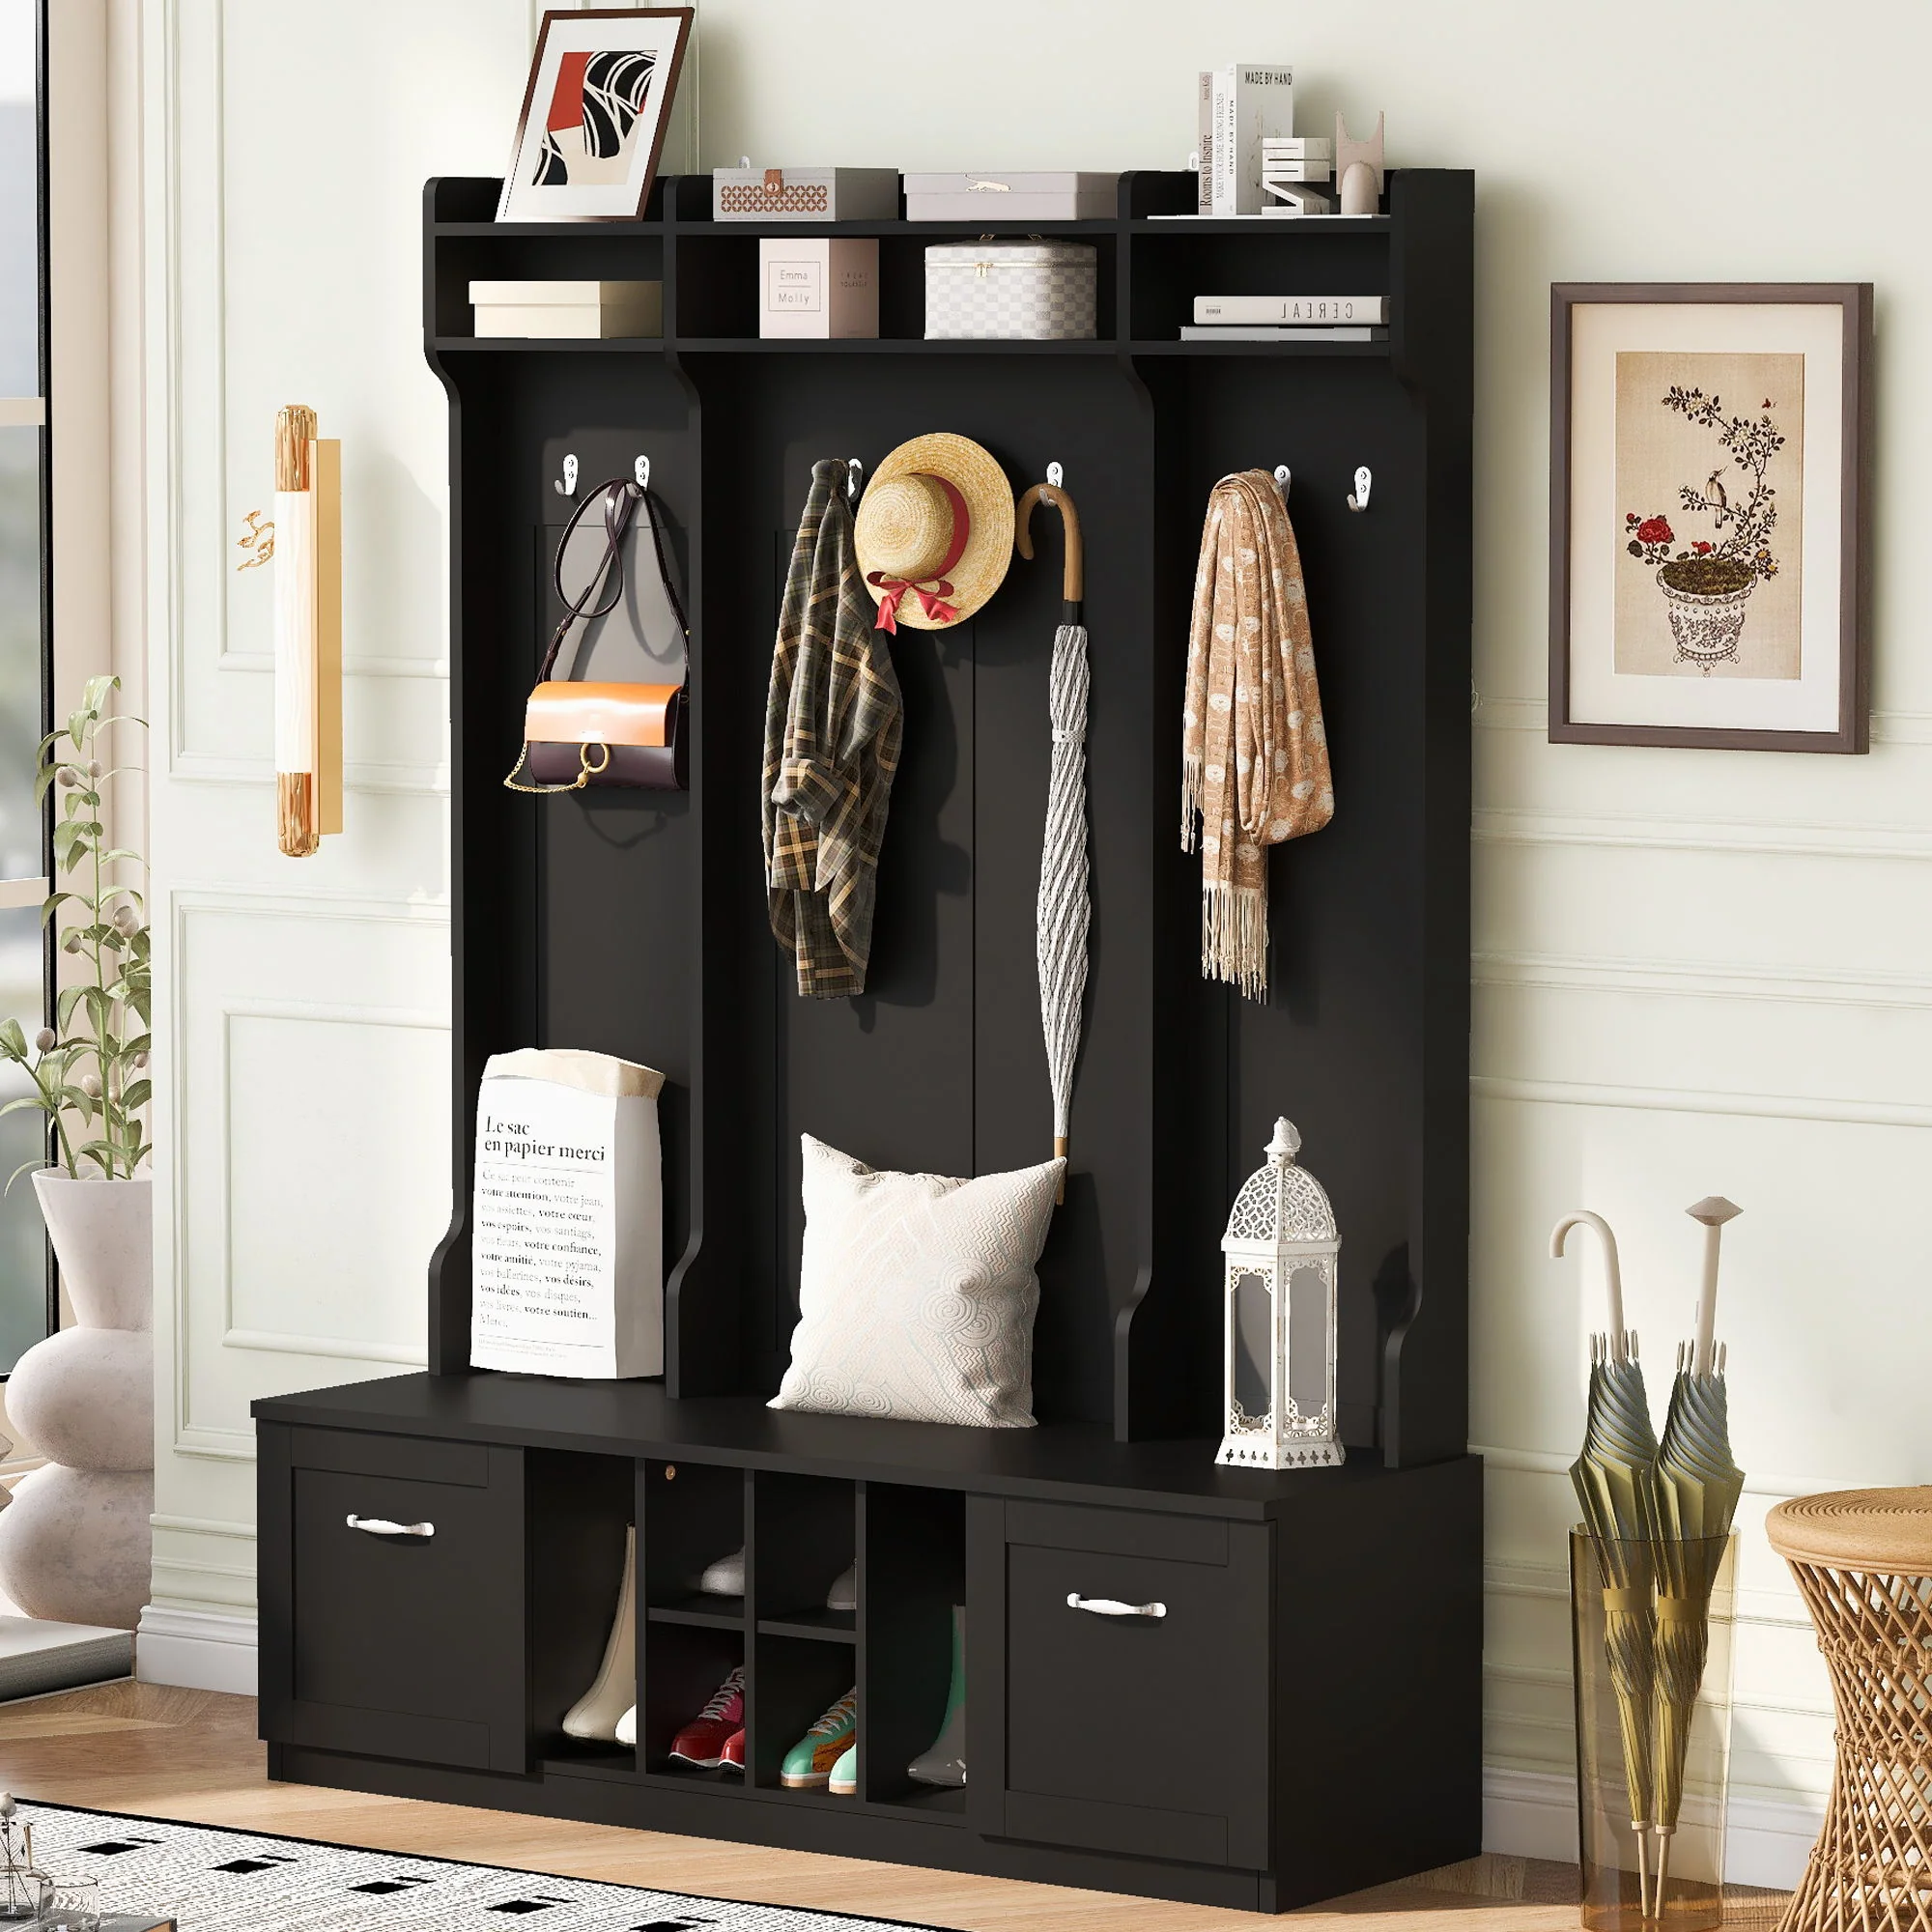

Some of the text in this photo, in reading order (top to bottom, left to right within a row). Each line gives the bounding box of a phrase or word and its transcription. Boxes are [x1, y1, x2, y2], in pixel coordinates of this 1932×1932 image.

[1245, 71, 1264, 84] MADE
[1264, 72, 1272, 84] BY
[1274, 72, 1292, 85] HAND
[1229, 131, 1234, 146] BY
[1199, 134, 1211, 207] Rooms to Inspire
[780, 270, 809, 280] Emma
[778, 293, 810, 305] Molly
[485, 1116, 530, 1135] Le sac
[484, 1139, 605, 1161] en papier merci
[533, 1177, 576, 1187] contenir
[504, 1190, 552, 1203] attention,
[554, 1194, 579, 1204] votre
[580, 1194, 604, 1208] jean,
[538, 1209, 566, 1219] votre
[497, 1222, 532, 1234] espoirs,
[535, 1226, 552, 1235] vos
[554, 1226, 595, 1239] santiags,
[524, 1240, 550, 1250] votre
[552, 1241, 602, 1256] confiance,
[539, 1258, 563, 1268] votre
[565, 1259, 602, 1273] pyjama,
[545, 1275, 561, 1284] vos
[563, 1273, 594, 1289] désirs,
[480, 1284, 581, 1304] vos idées, vos disques,
[525, 1306, 551, 1316] votre
